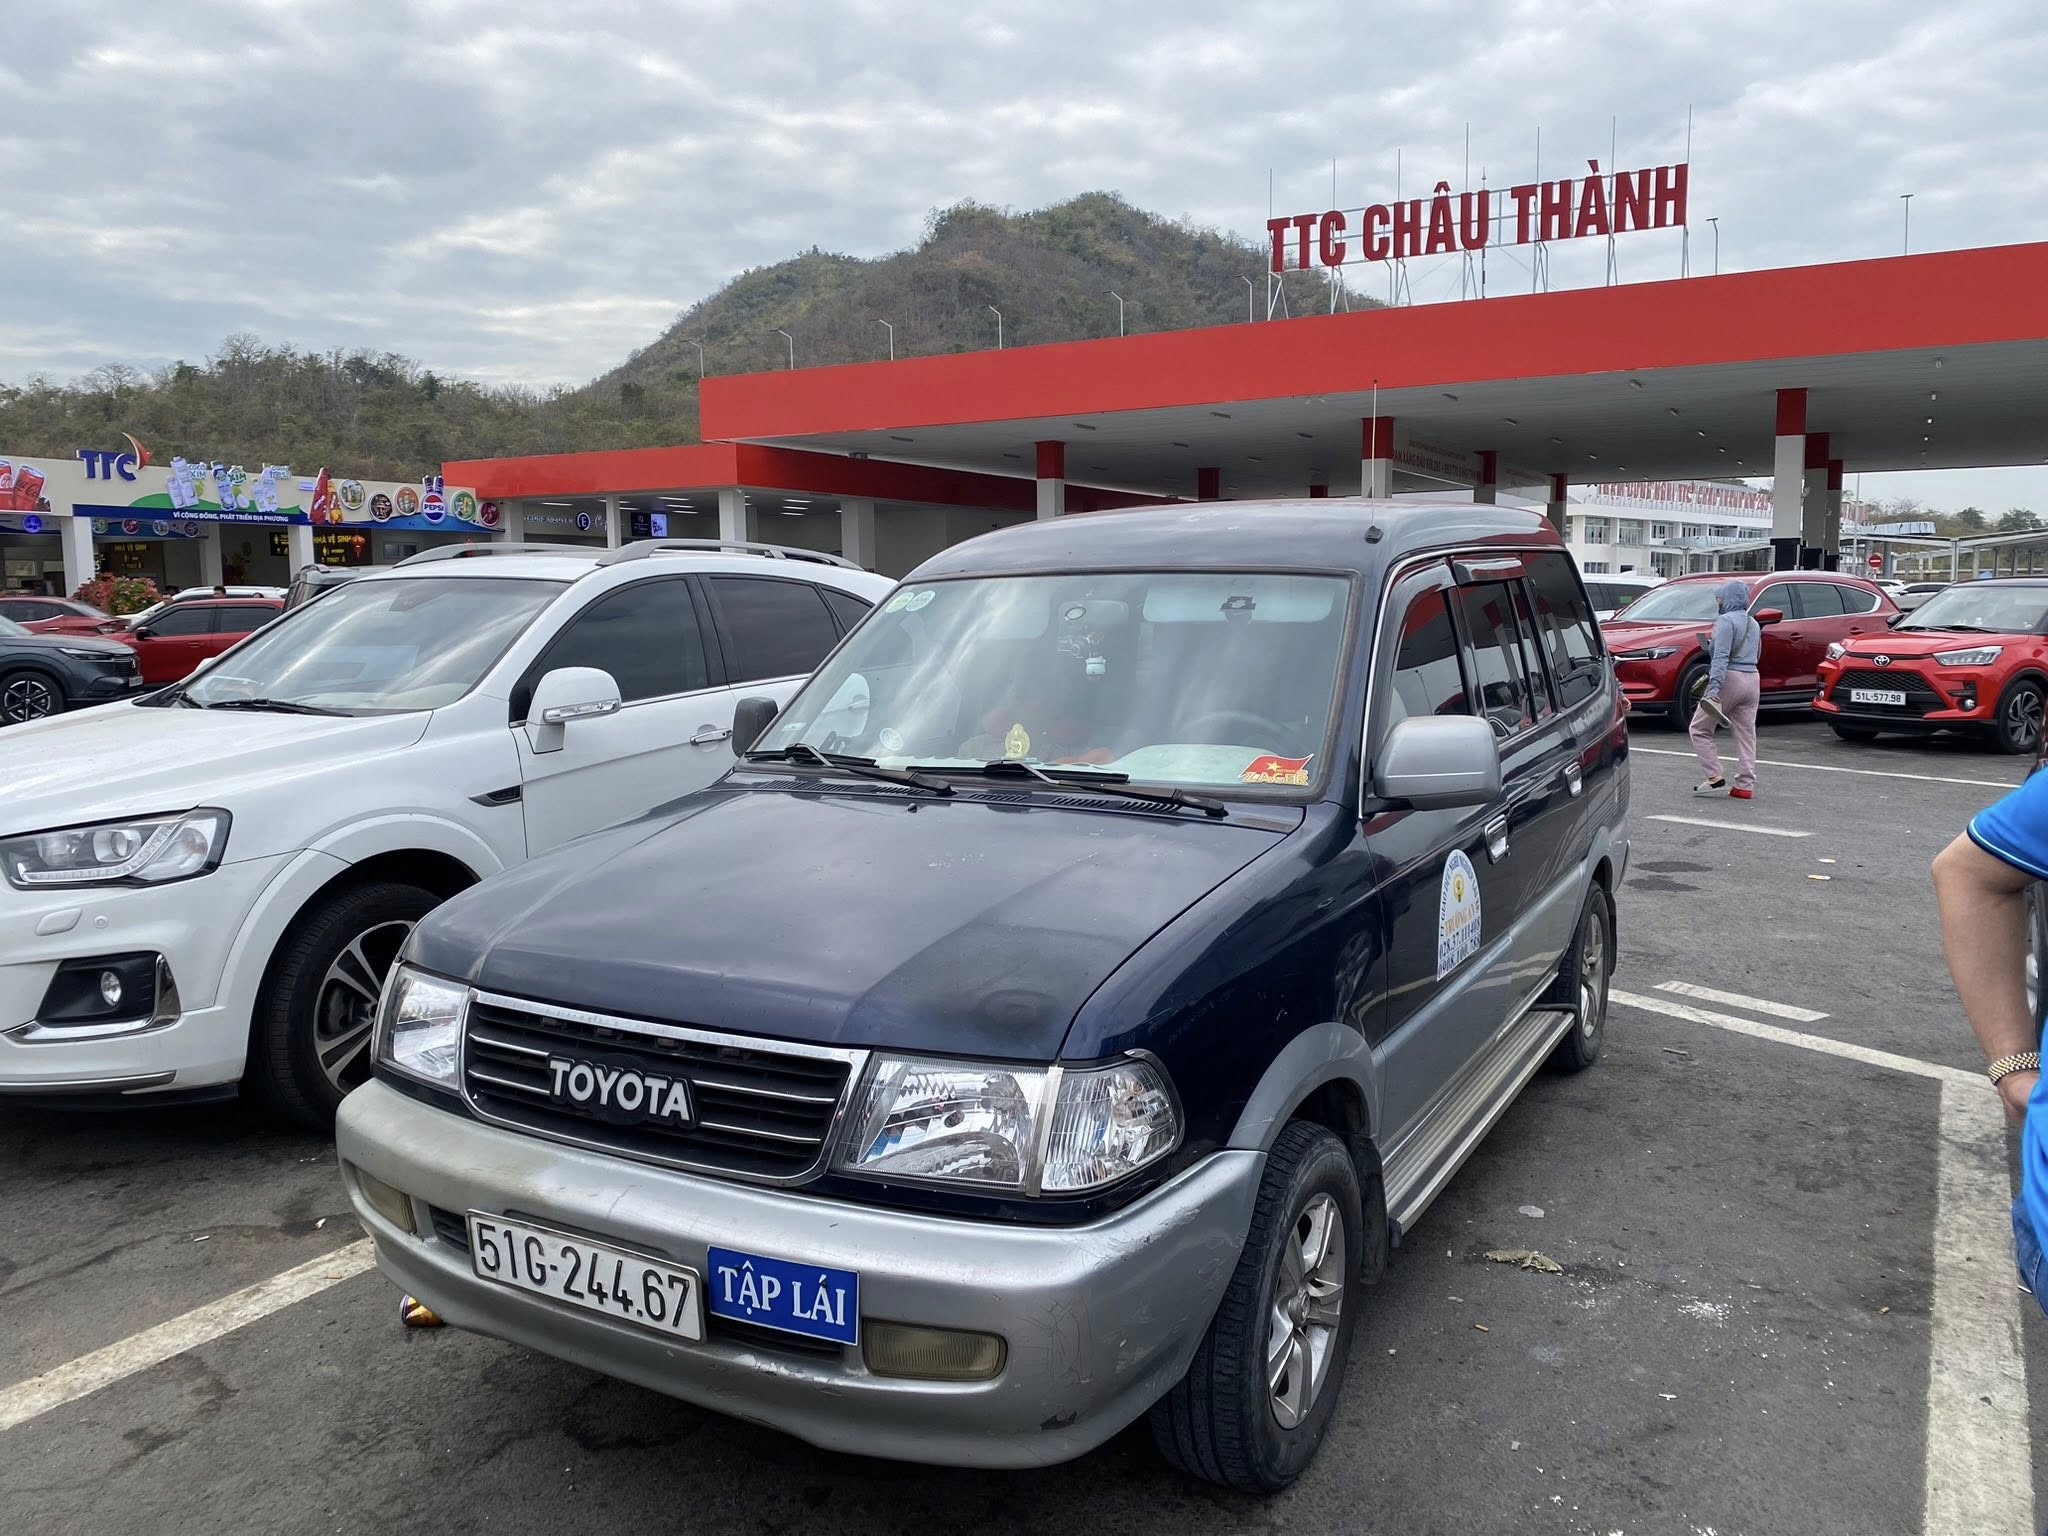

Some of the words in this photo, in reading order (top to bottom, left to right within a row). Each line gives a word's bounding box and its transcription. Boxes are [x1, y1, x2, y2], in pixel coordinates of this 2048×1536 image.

[1267, 210, 1346, 273] TTC
[1362, 181, 1490, 262] CHÂU
[1510, 159, 1689, 244] THÀNH
[76, 449, 137, 481] TTC
[424, 503, 445, 512] PEPSI
[1855, 692, 1902, 703] 51L-577.98
[1243, 771, 1309, 786] ZAGER
[549, 1059, 691, 1122] TOYOTA
[476, 1222, 691, 1328] 51G-244.67
[717, 1259, 782, 1316] TẬP
[791, 1274, 846, 1327] LÁI
